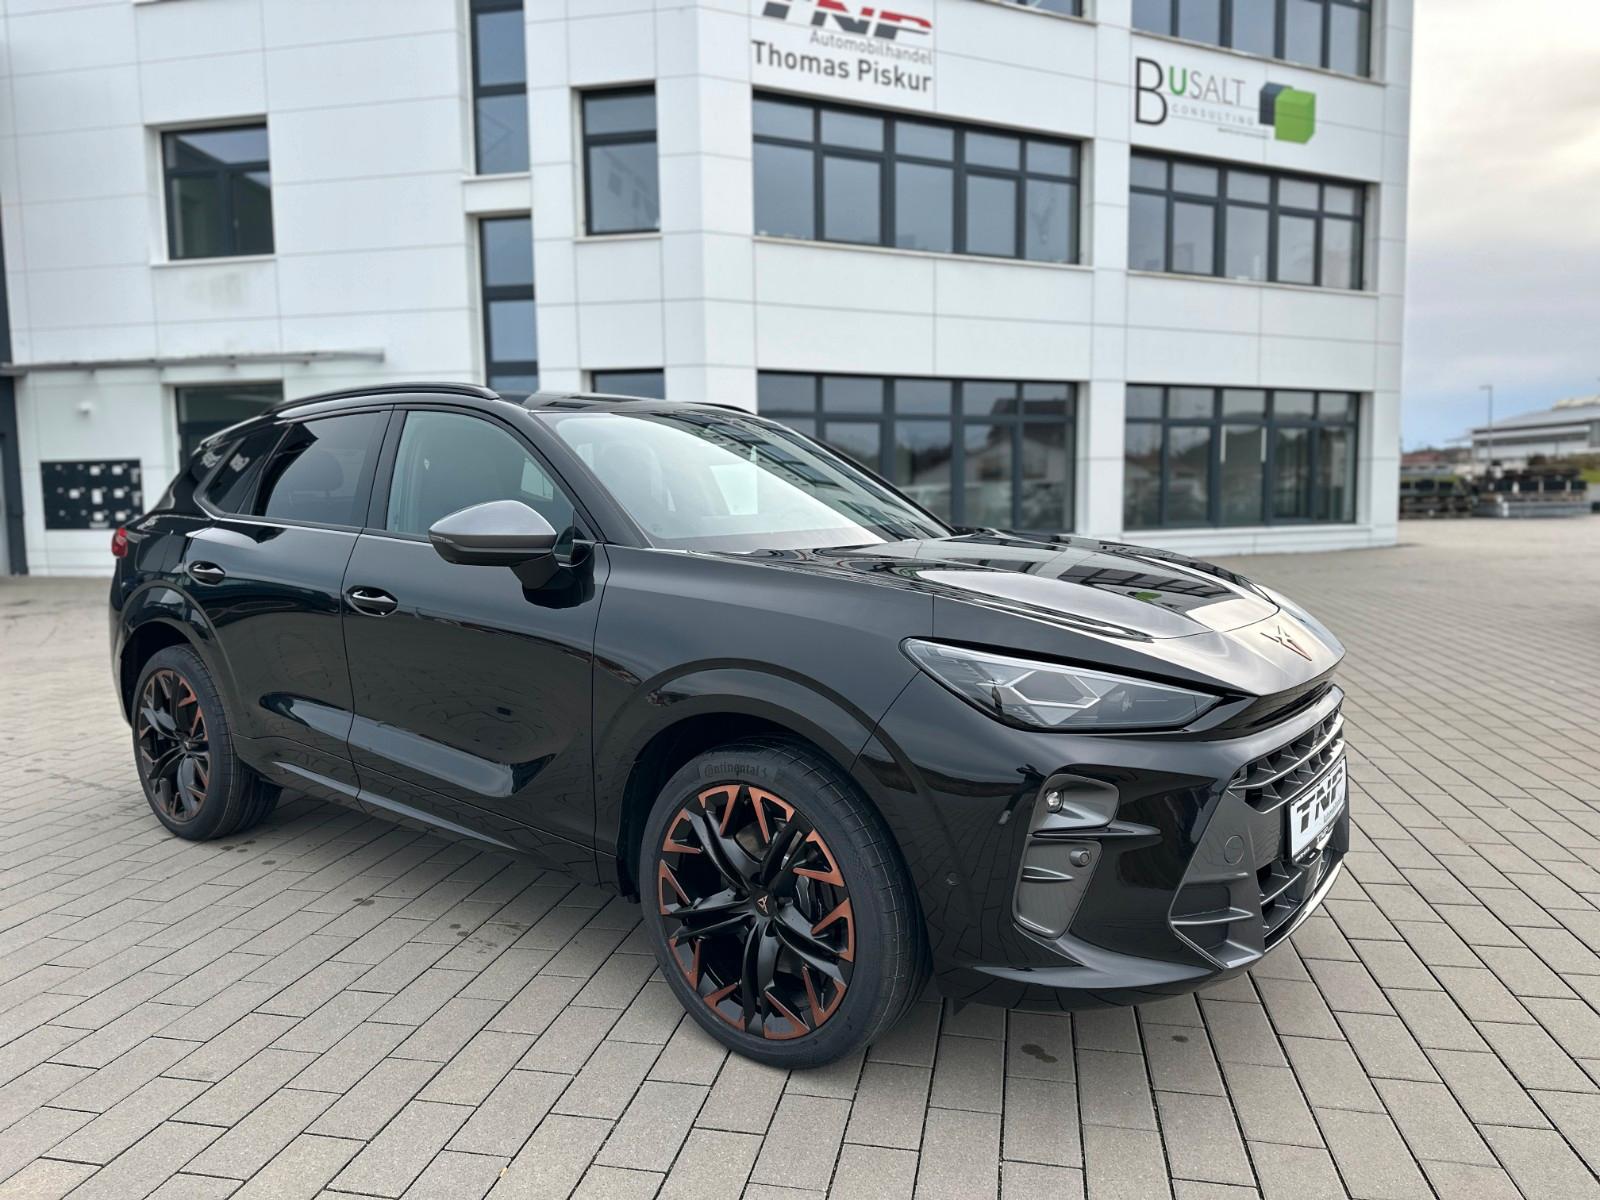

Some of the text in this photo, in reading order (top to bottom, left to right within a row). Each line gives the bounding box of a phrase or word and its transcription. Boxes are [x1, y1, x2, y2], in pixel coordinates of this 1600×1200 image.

[752, 40, 932, 92] Thomas Piskur
[809, 30, 932, 65] Automobilhandel
[1135, 57, 1245, 126] BUSALT
[1171, 103, 1254, 126] CONSULTING
[1297, 766, 1343, 833] TNP
